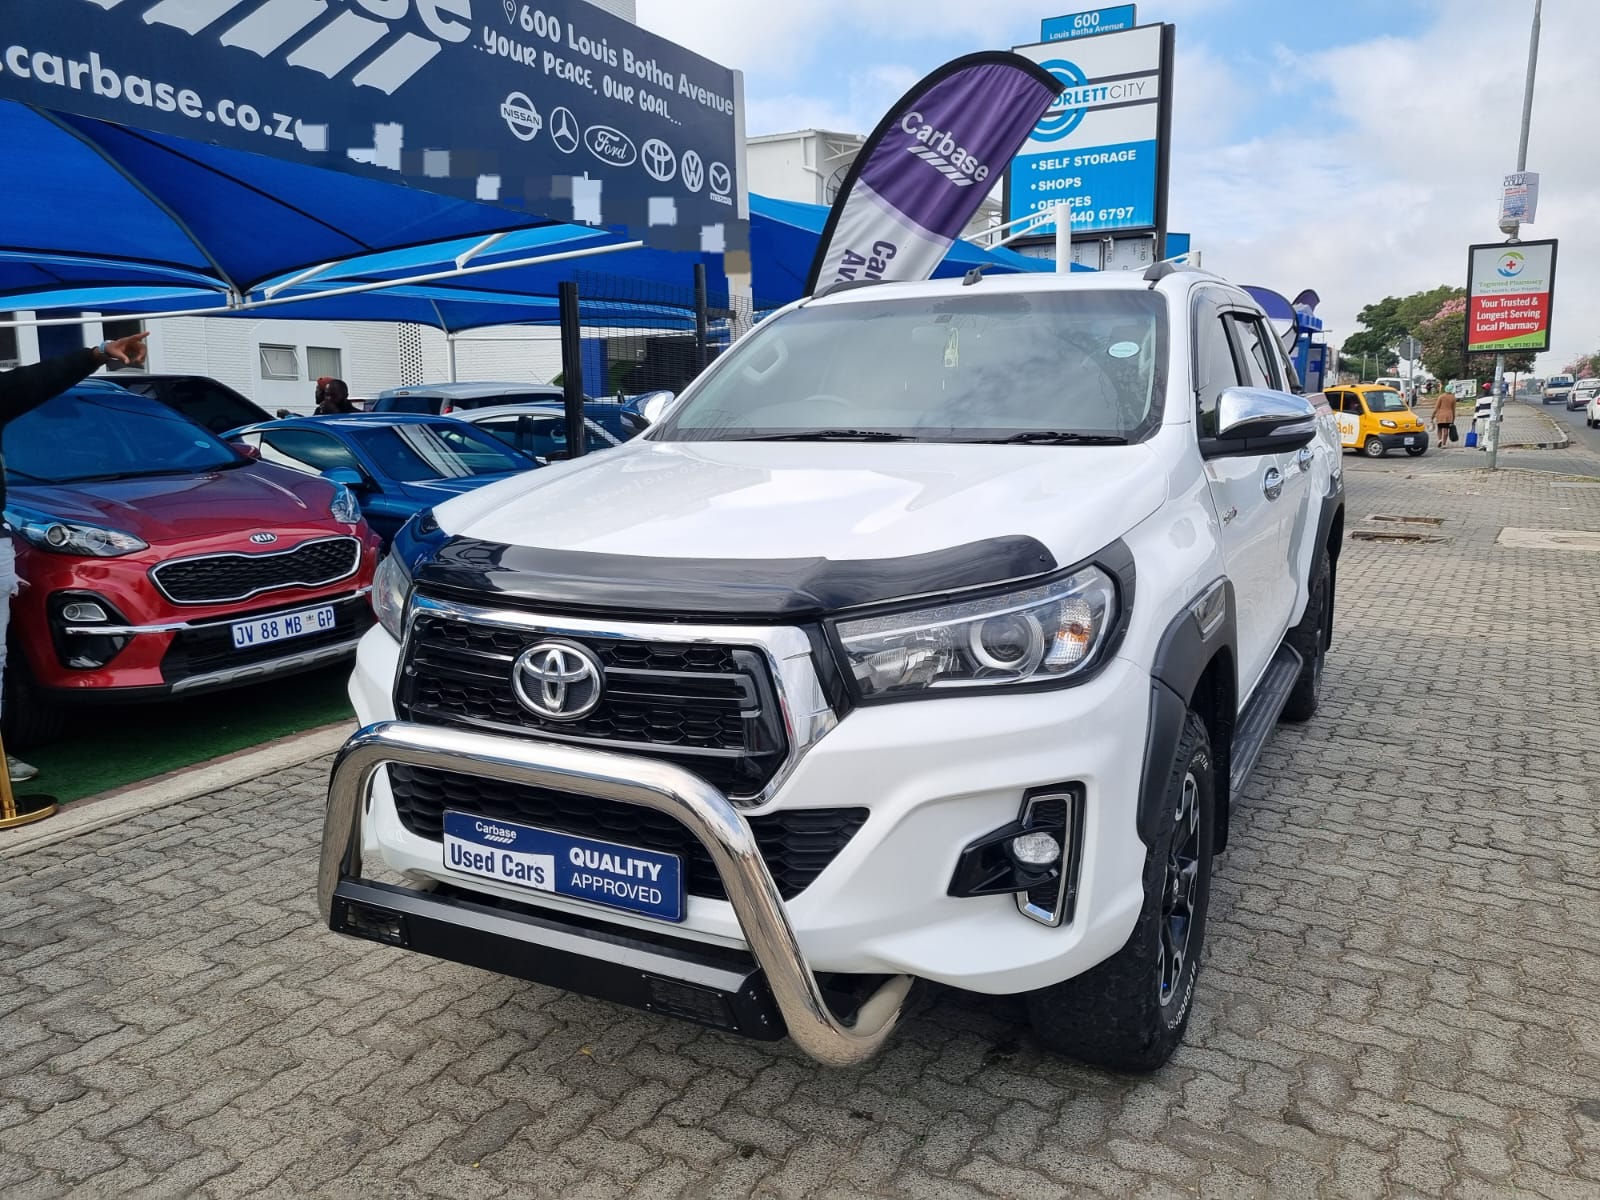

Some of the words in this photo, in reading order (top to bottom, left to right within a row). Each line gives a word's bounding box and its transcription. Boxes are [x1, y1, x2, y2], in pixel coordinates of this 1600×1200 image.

[1073, 12, 1100, 28] 600
[1049, 30, 1069, 40] Louis
[1071, 26, 1093, 37] Botha
[1094, 22, 1124, 32] Avenue
[520, 5, 561, 43] 600
[568, 23, 618, 67] Louis
[622, 47, 674, 91] Botha
[678, 73, 734, 116] Avenue
[0, 45, 303, 142] carbase.co.z
[1051, 81, 1146, 107] ORLETTCITY
[503, 107, 541, 127] NISSAN
[594, 130, 627, 160] Ford
[901, 111, 989, 182] Carbase
[1038, 157, 1070, 171] SELF
[1074, 150, 1137, 167] STORAGE
[1038, 177, 1082, 191] SHOPS
[1099, 206, 1135, 221] 6797
[834, 249, 867, 283] Av
[1480, 299, 1499, 308] Your
[1500, 298, 1530, 307] Trusted
[1531, 297, 1538, 305] &
[1476, 310, 1508, 321] Longest
[1510, 310, 1541, 319] Serving
[1476, 322, 1497, 331] Local
[1499, 321, 1539, 331] Pharmacy
[253, 533, 275, 542] KIA
[236, 625, 254, 645] JV
[261, 621, 279, 640] 88
[285, 616, 302, 635] MB
[317, 609, 333, 628] GP
[475, 821, 518, 840] Carbase
[450, 842, 495, 873] Used
[501, 854, 546, 885] Cars
[569, 847, 663, 882] QUALITY
[571, 872, 662, 905] APPROVED
